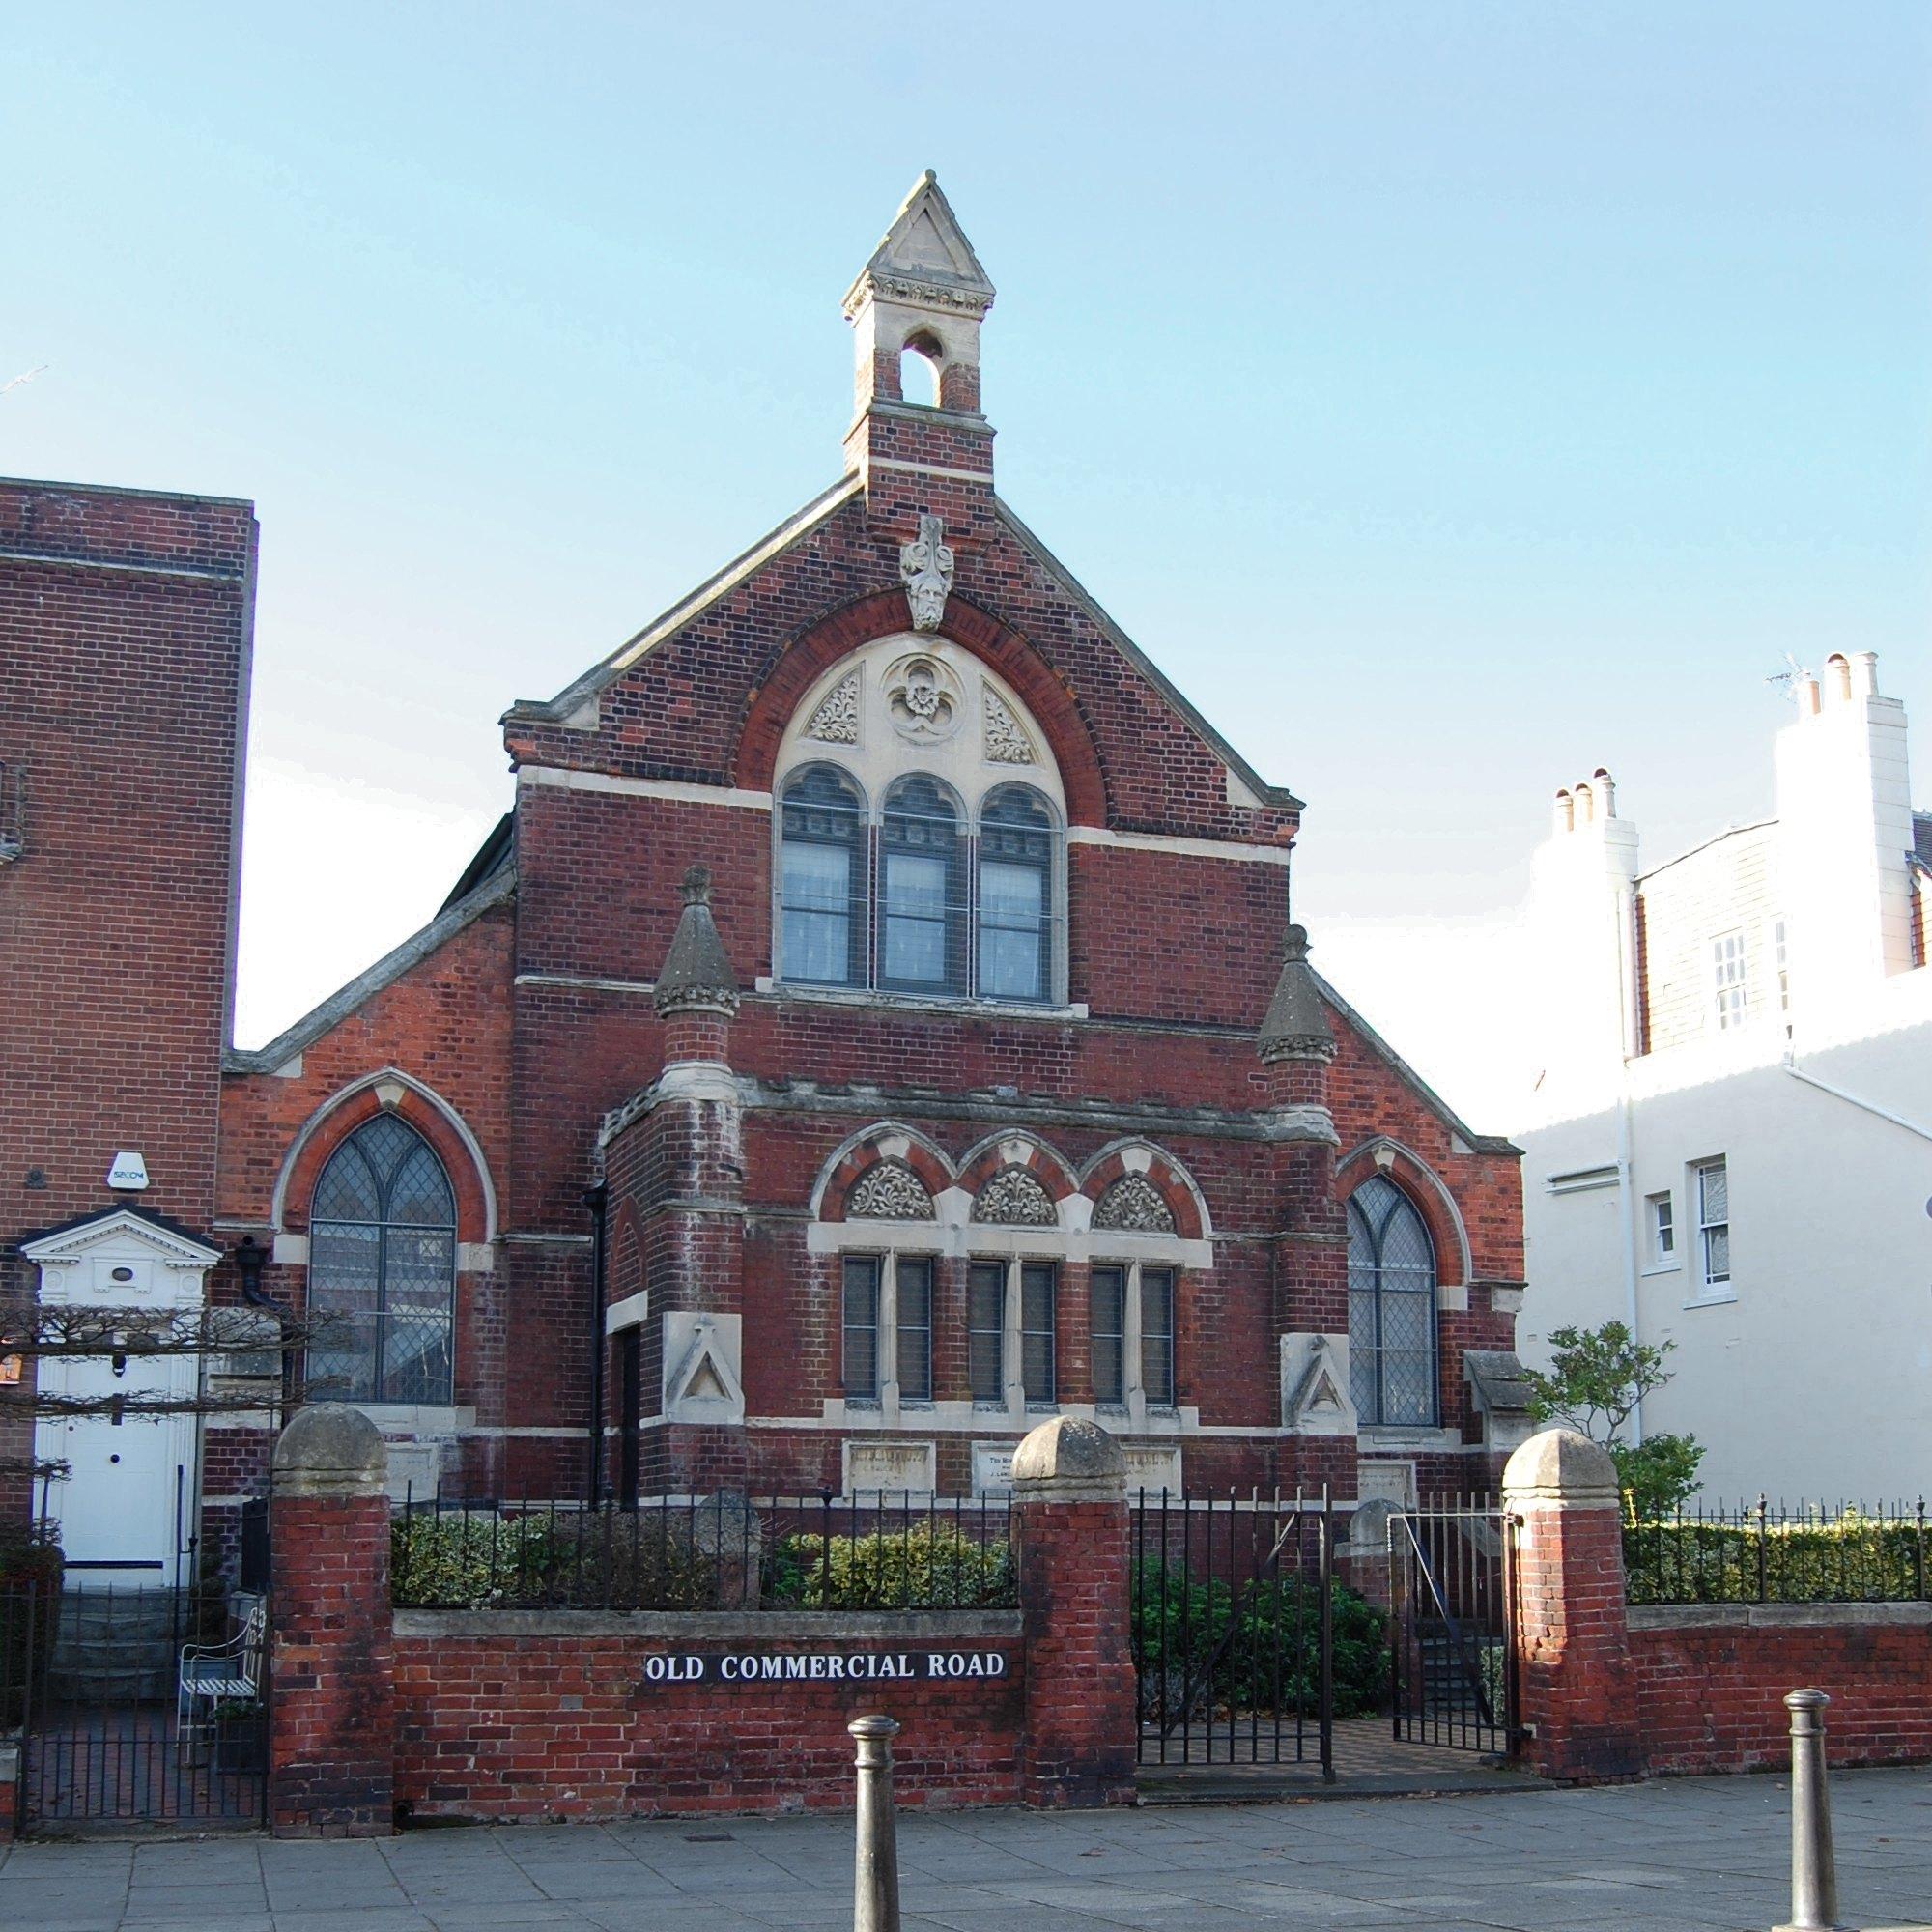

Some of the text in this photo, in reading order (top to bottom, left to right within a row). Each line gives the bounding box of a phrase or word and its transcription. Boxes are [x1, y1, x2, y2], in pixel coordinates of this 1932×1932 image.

[646, 1653, 1004, 1680] OLD COMMERCIAL ROAD
